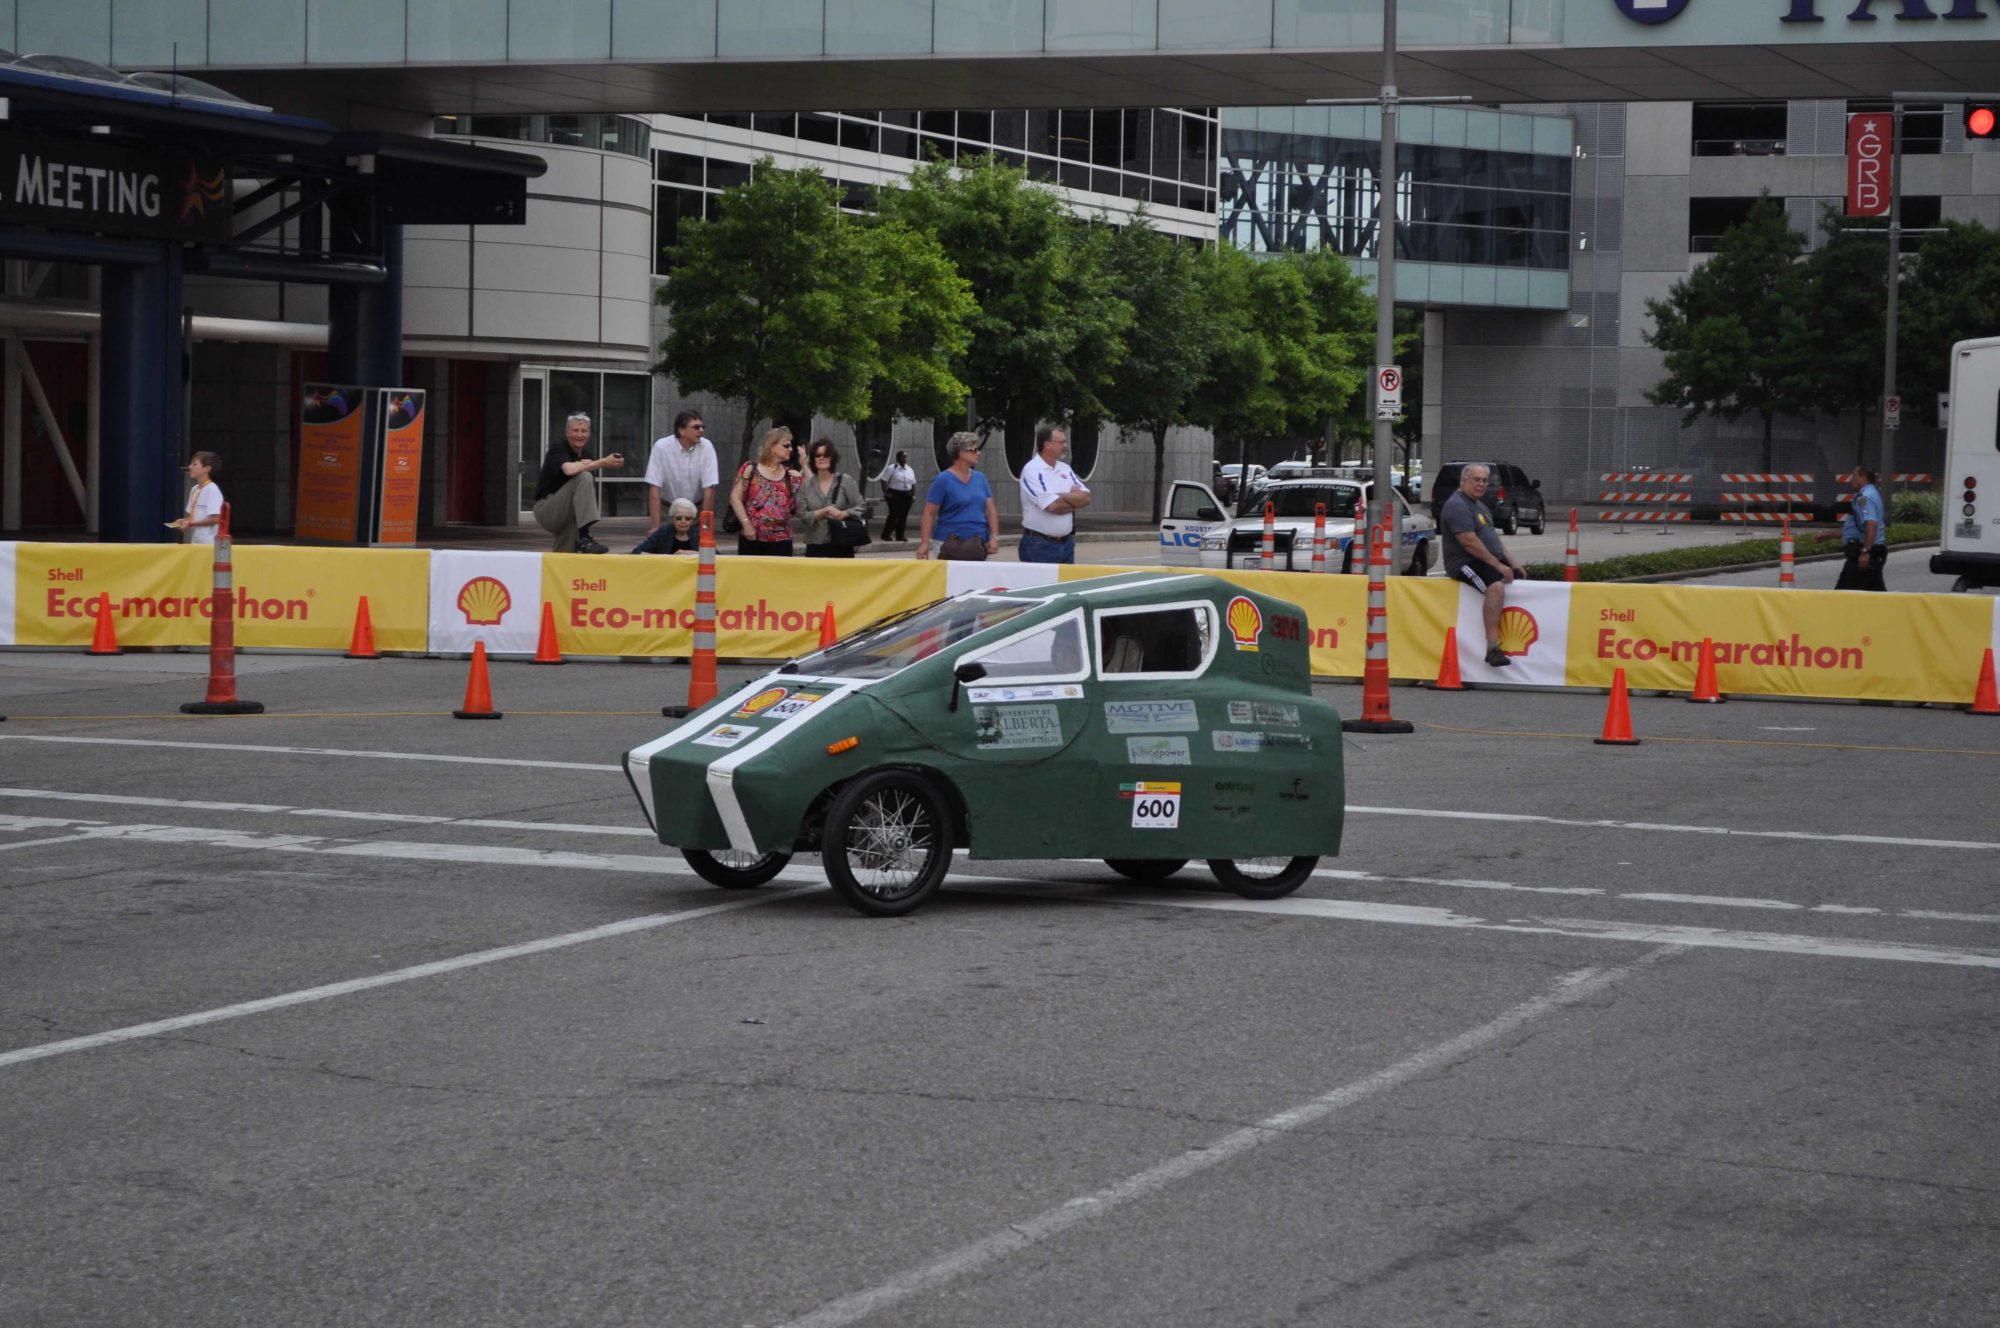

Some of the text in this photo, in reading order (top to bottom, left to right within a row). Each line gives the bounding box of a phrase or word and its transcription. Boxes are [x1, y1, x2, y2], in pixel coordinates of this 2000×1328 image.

[1857, 133, 1882, 208] GRB
[15, 153, 161, 217] MEETING
[47, 567, 83, 581] Shell
[572, 578, 607, 592] Shell
[47, 586, 309, 621] Eco-marahon
[570, 598, 826, 632] Eco-maathon
[1600, 608, 1635, 622] Shell
[1269, 614, 1300, 641] 3M
[773, 702, 806, 714] 600
[1109, 702, 1193, 713] MOTIVE
[999, 716, 1057, 731] ALBERTA
[1136, 799, 1176, 818] 600
